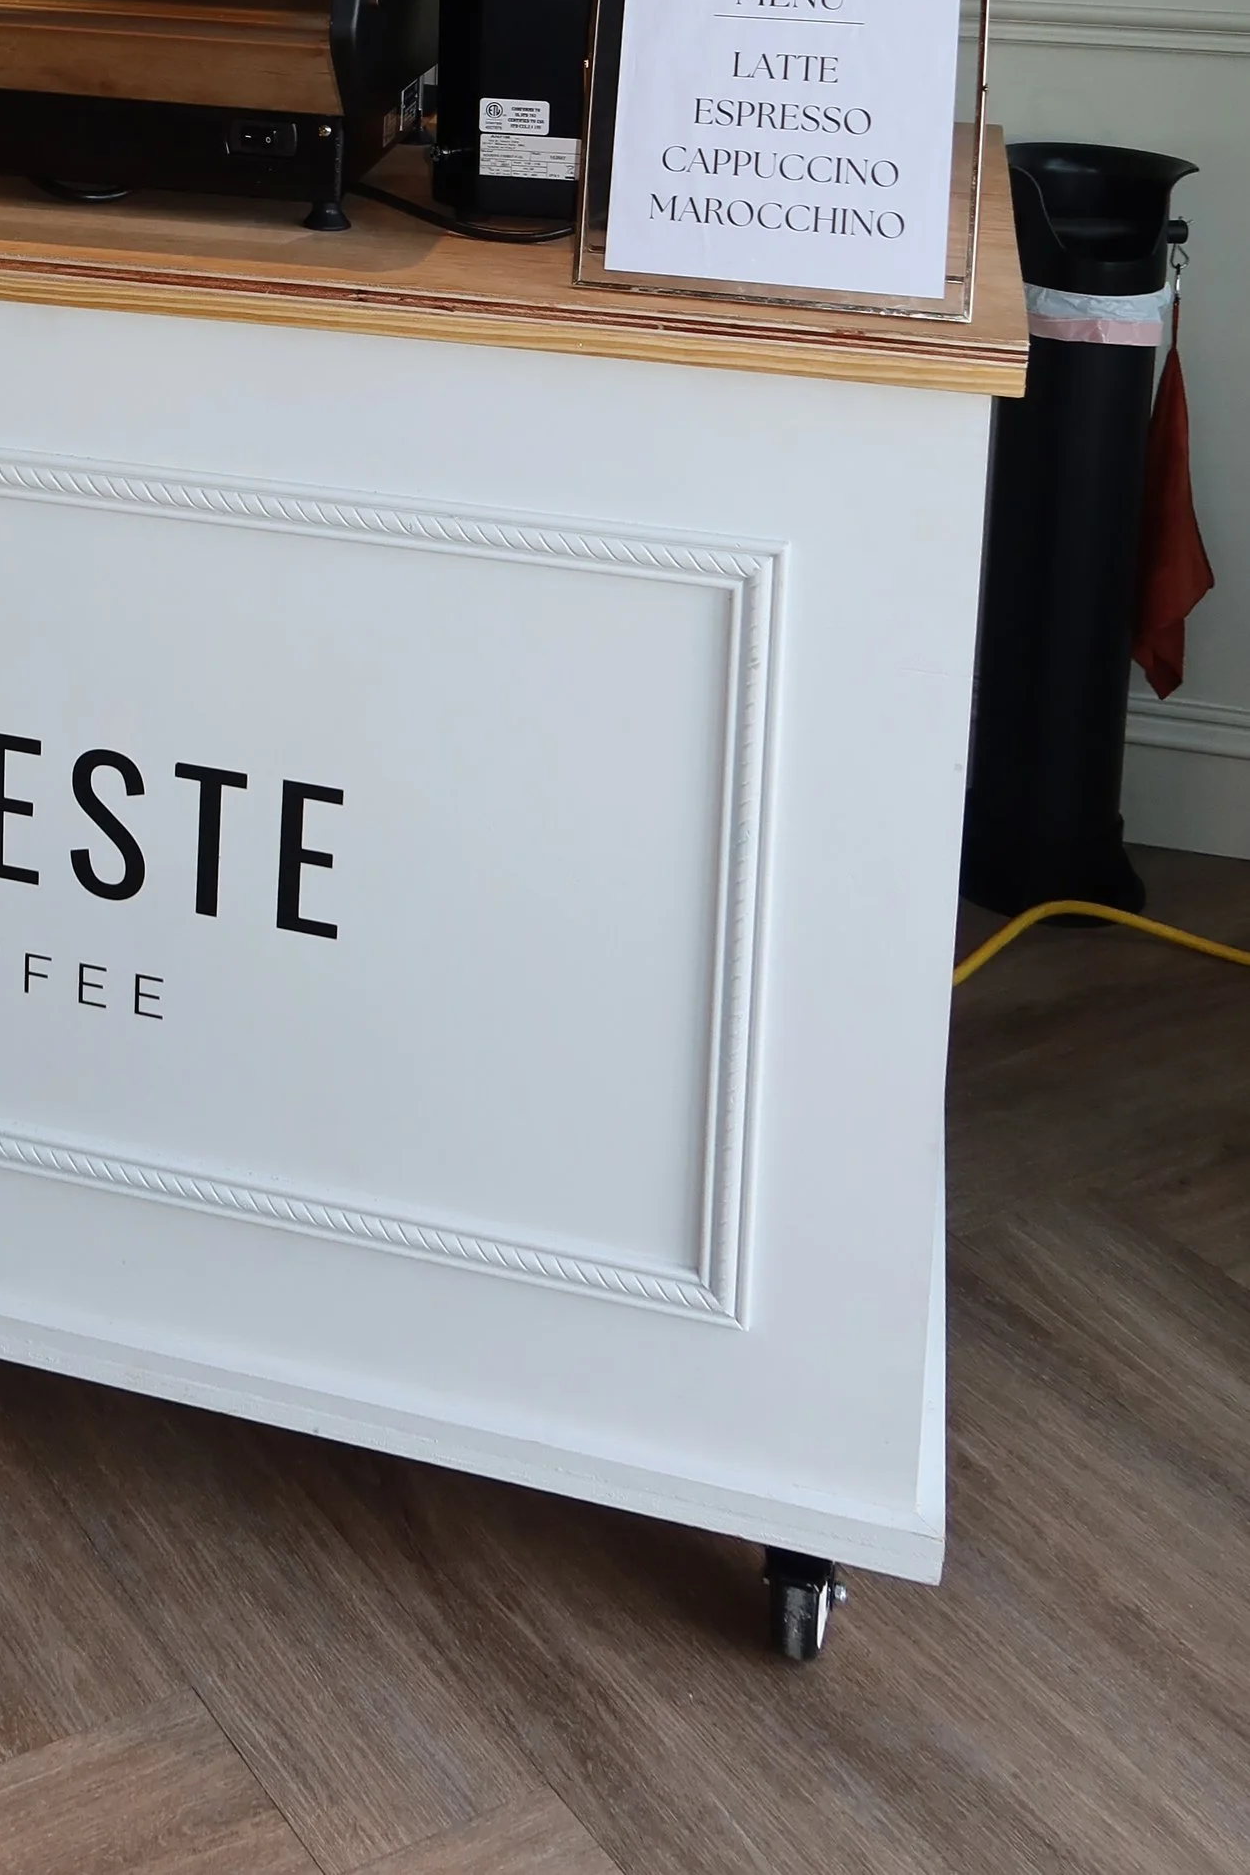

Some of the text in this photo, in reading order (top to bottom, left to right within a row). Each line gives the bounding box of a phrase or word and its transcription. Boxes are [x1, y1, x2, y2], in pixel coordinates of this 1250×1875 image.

[732, 51, 839, 84] LATTE
[694, 97, 872, 135] ESPRESSO
[661, 144, 899, 188] CAPPUCCINO
[649, 192, 905, 239] MAROCCHINO
